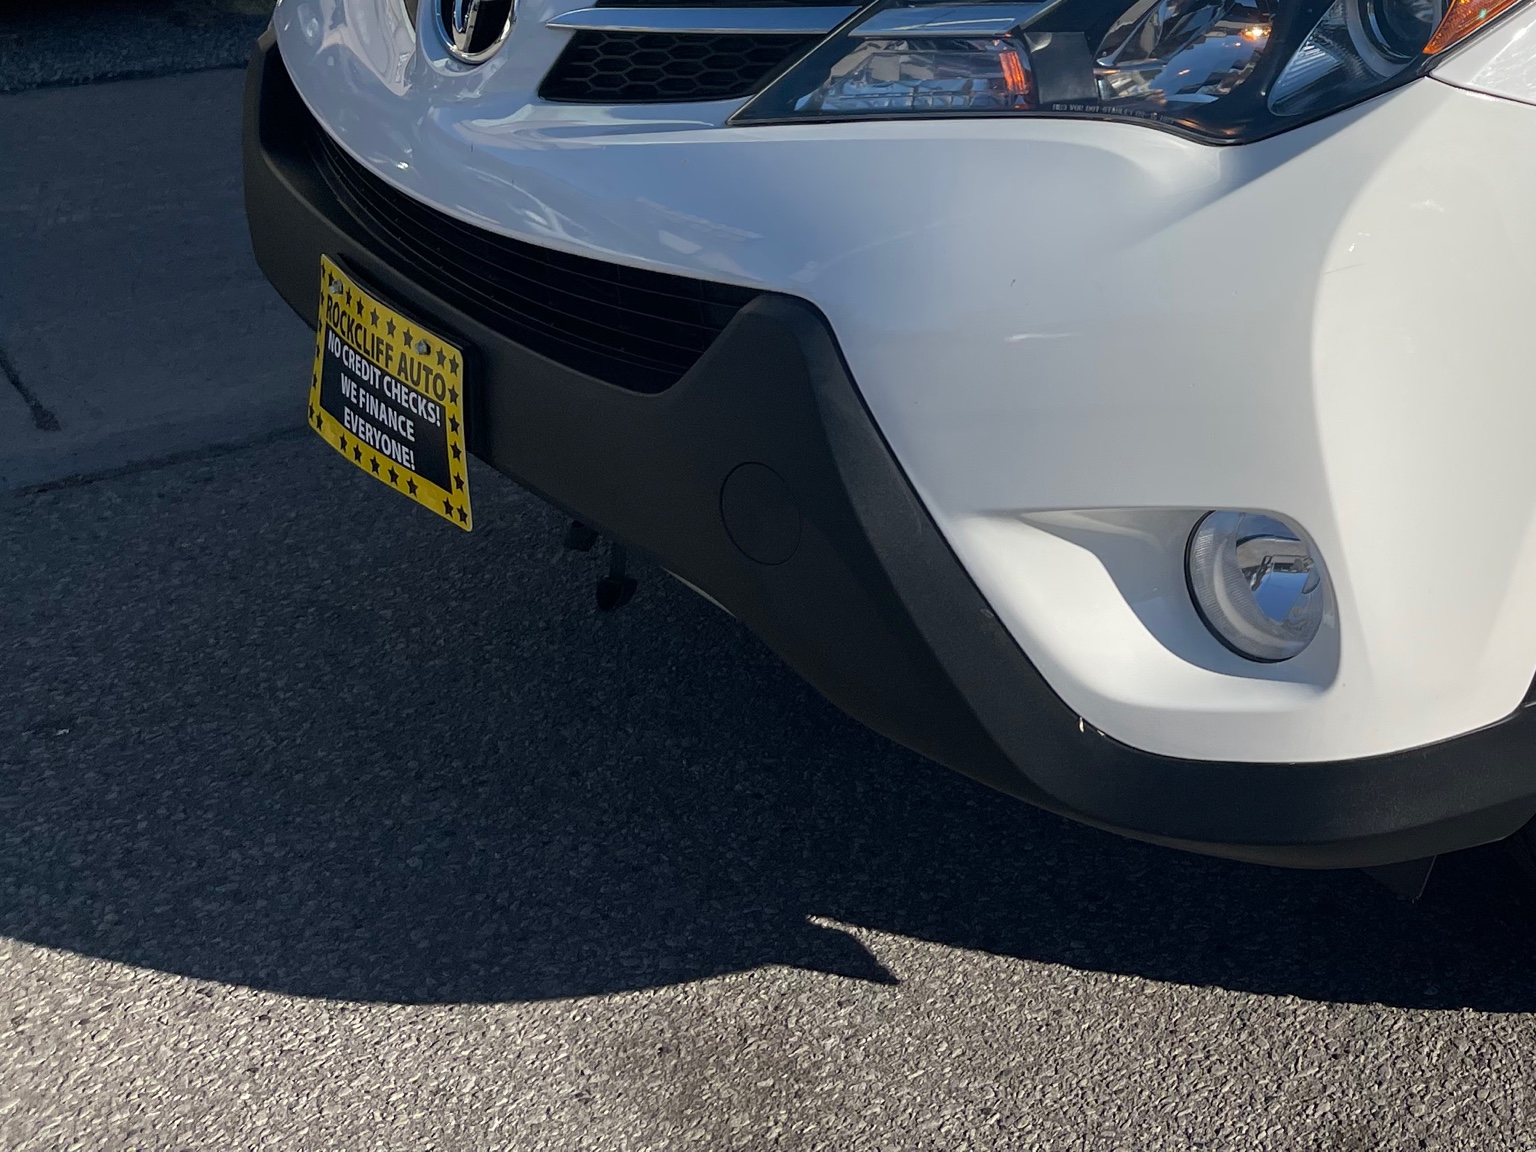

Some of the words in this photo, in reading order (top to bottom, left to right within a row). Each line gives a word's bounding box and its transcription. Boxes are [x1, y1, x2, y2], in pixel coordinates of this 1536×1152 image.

[326, 294, 394, 369] ROCKCLIFF
[397, 353, 447, 402] AUTO
[328, 330, 341, 358] NO
[342, 346, 380, 390] CREDIT
[383, 375, 441, 428] CHECKS!
[340, 373, 357, 399] WE
[359, 389, 415, 442] FINANCE
[343, 406, 416, 471] EVERYONE!
